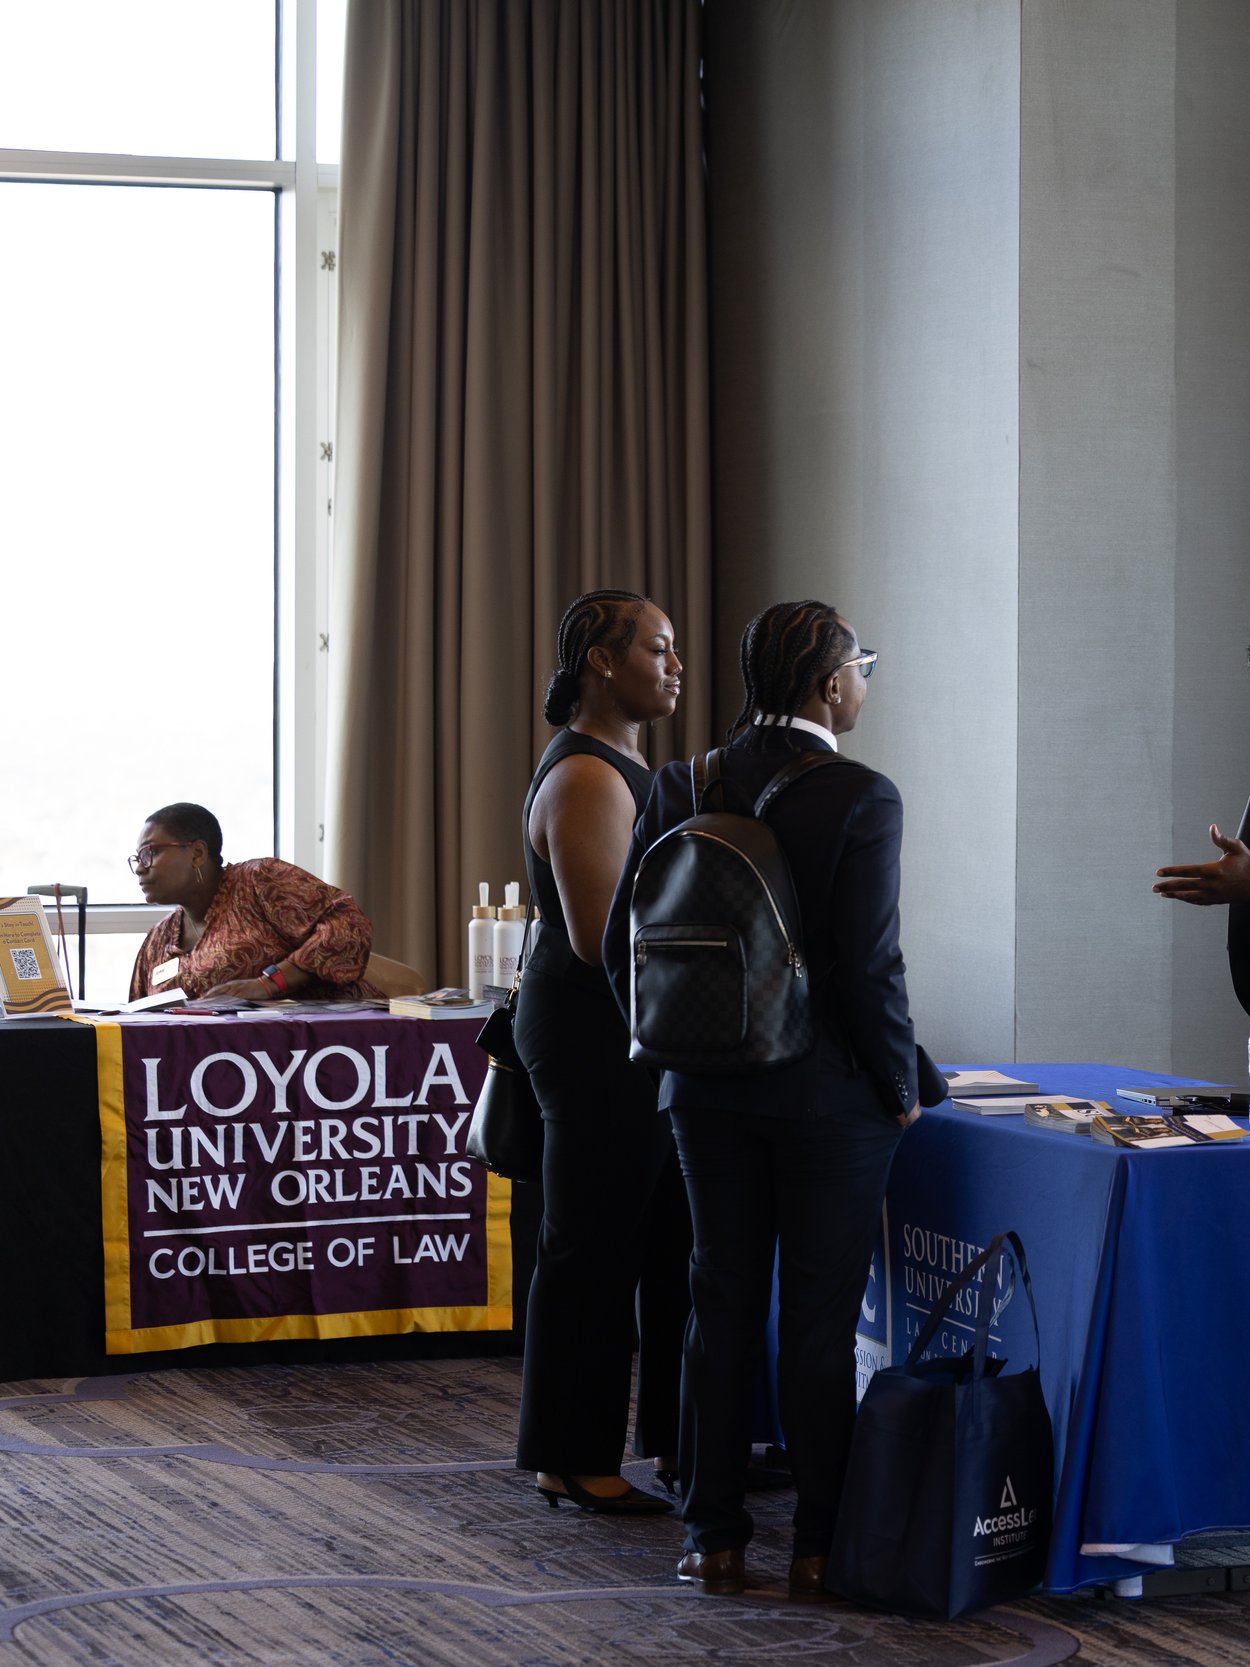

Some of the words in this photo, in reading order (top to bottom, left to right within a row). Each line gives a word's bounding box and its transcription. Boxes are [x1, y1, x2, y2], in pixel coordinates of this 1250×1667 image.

[141, 1042, 472, 1122] LOYOLA
[144, 1111, 471, 1170] UNIVERSITY
[145, 1173, 247, 1214] NEW
[271, 1161, 473, 1206] ORLEANS
[149, 1241, 315, 1279] COLLEGE
[326, 1237, 375, 1268] OF
[393, 1233, 471, 1264] LAW
[904, 1265, 1002, 1327] UNIVRSIY
[941, 1331, 998, 1359] CEN
[973, 1507, 1037, 1537] AccessLe
[992, 1530, 1028, 1547] INSTITUTE
